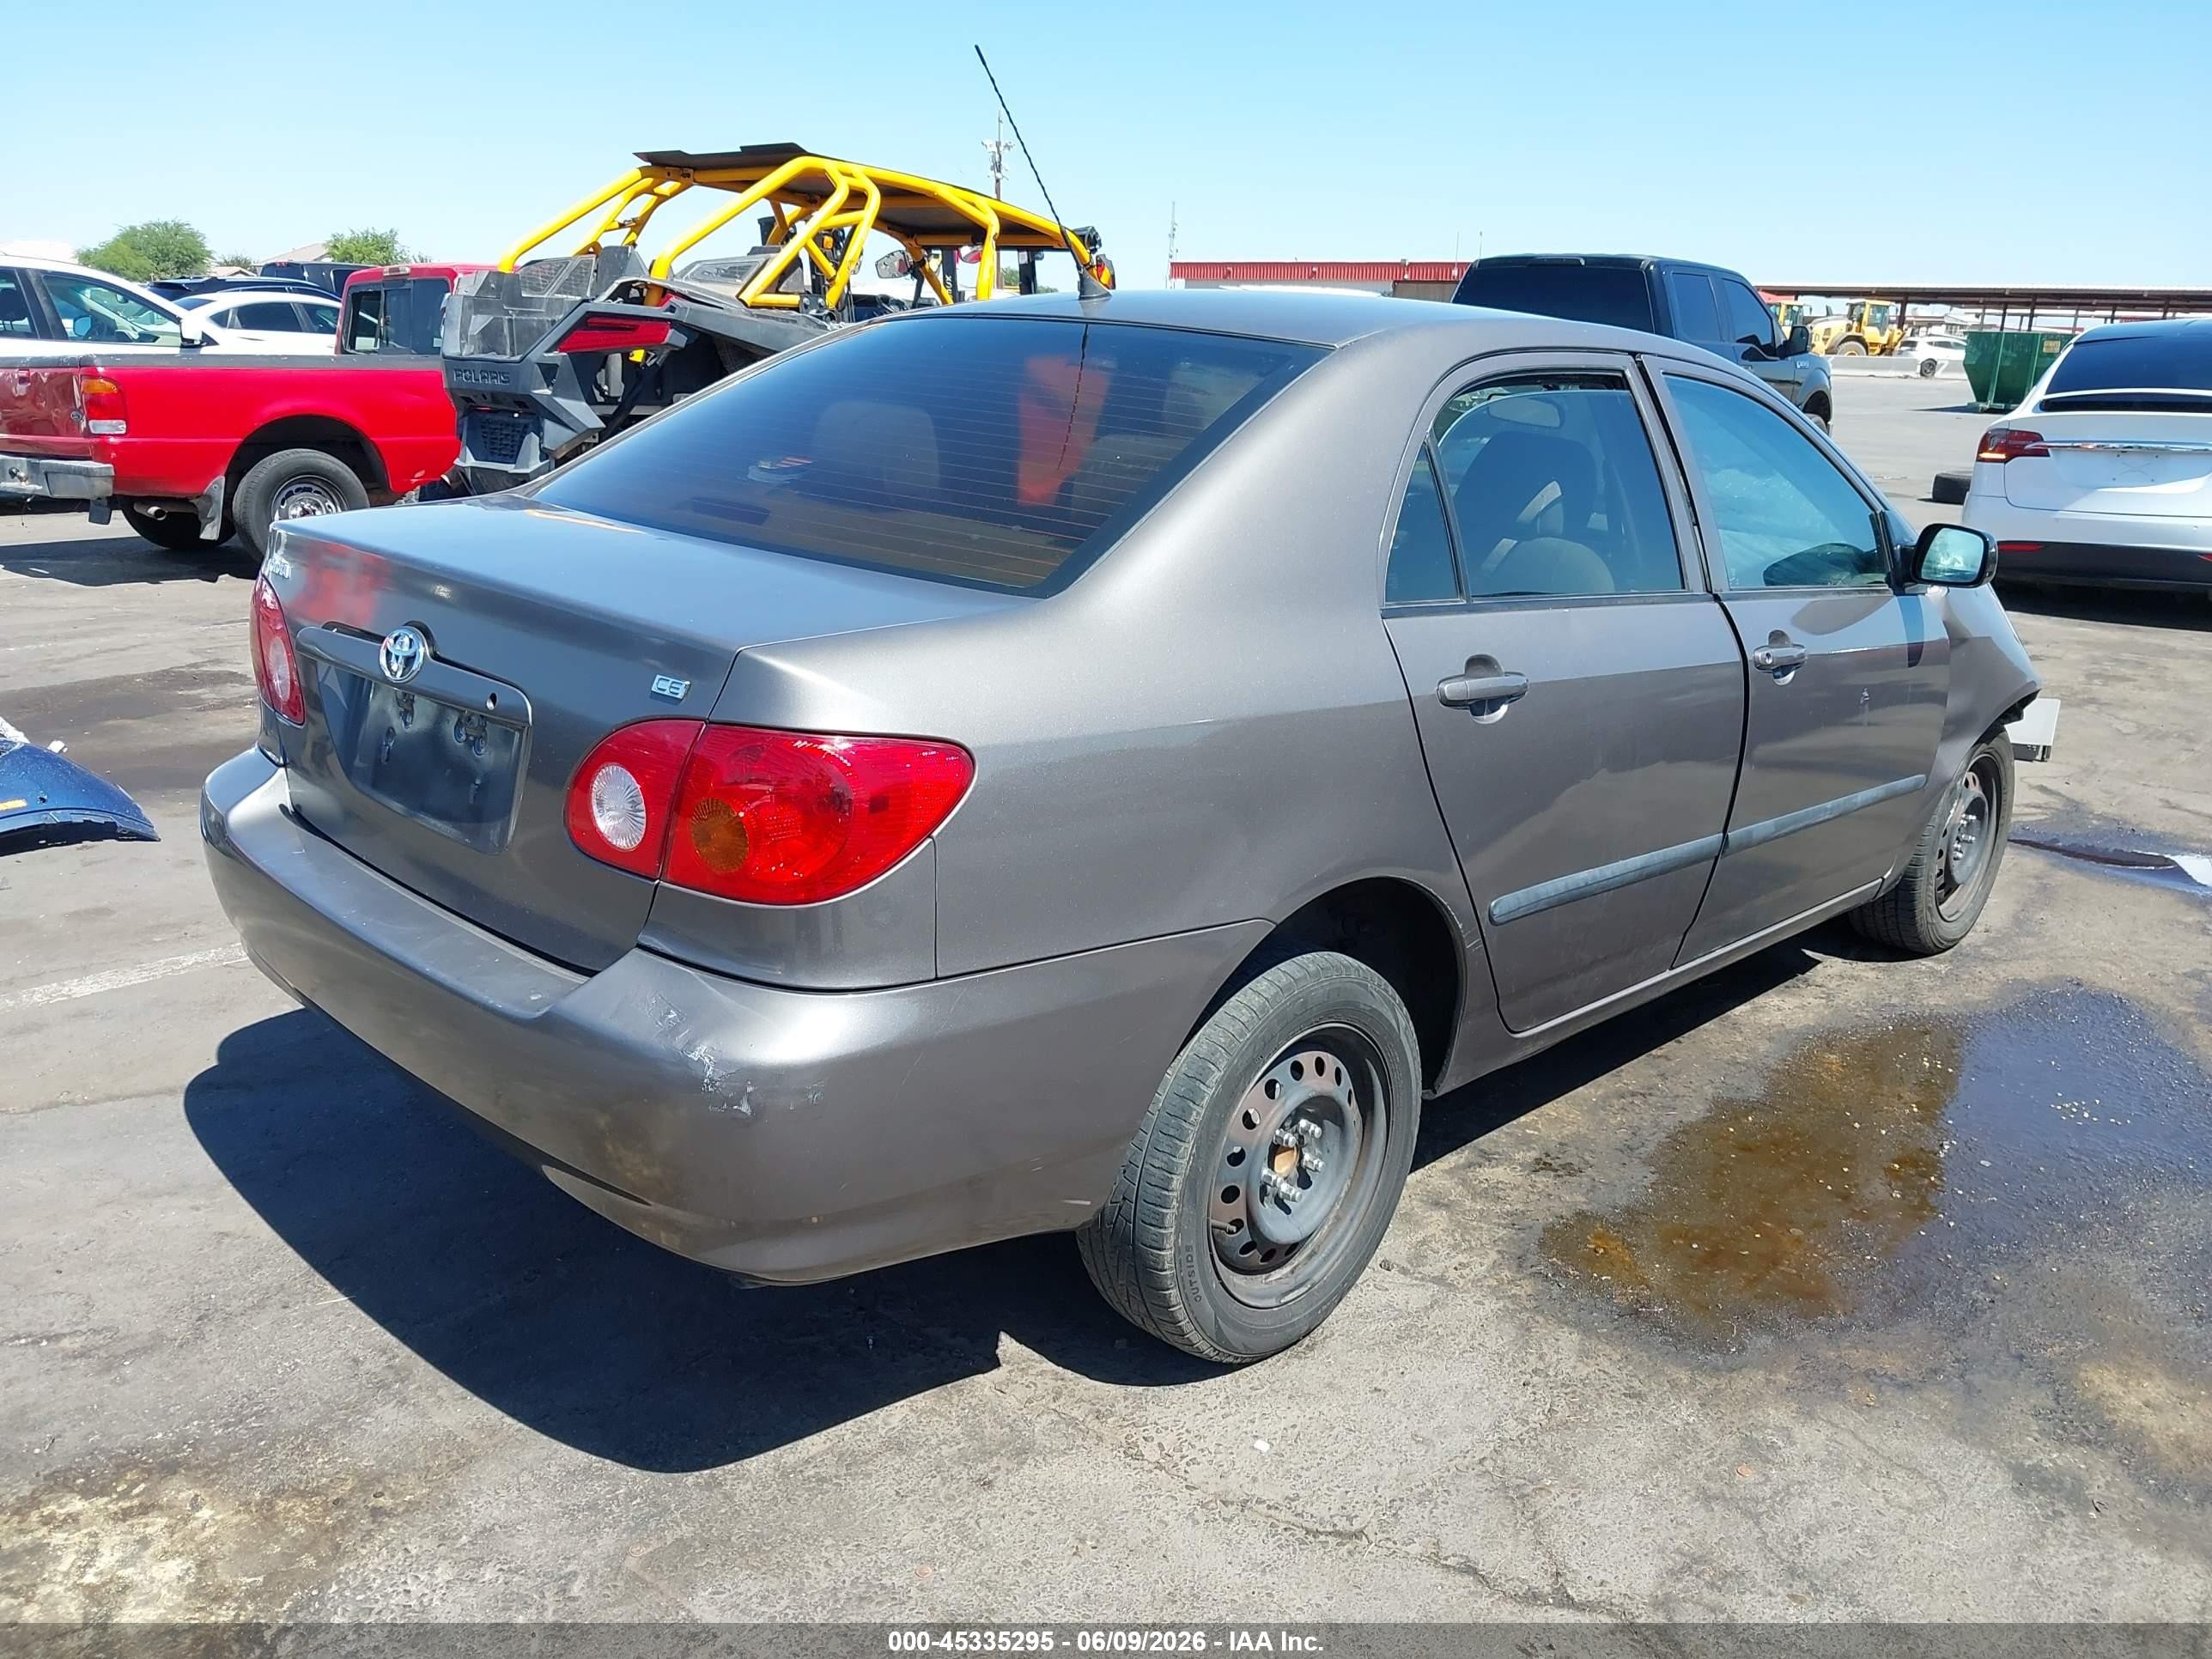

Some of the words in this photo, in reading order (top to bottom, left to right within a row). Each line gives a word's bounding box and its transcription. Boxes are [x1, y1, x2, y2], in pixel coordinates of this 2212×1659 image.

[453, 368, 510, 386] POLARIS
[653, 676, 685, 696] CE
[1185, 1243, 1201, 1302] OUTSIDE
